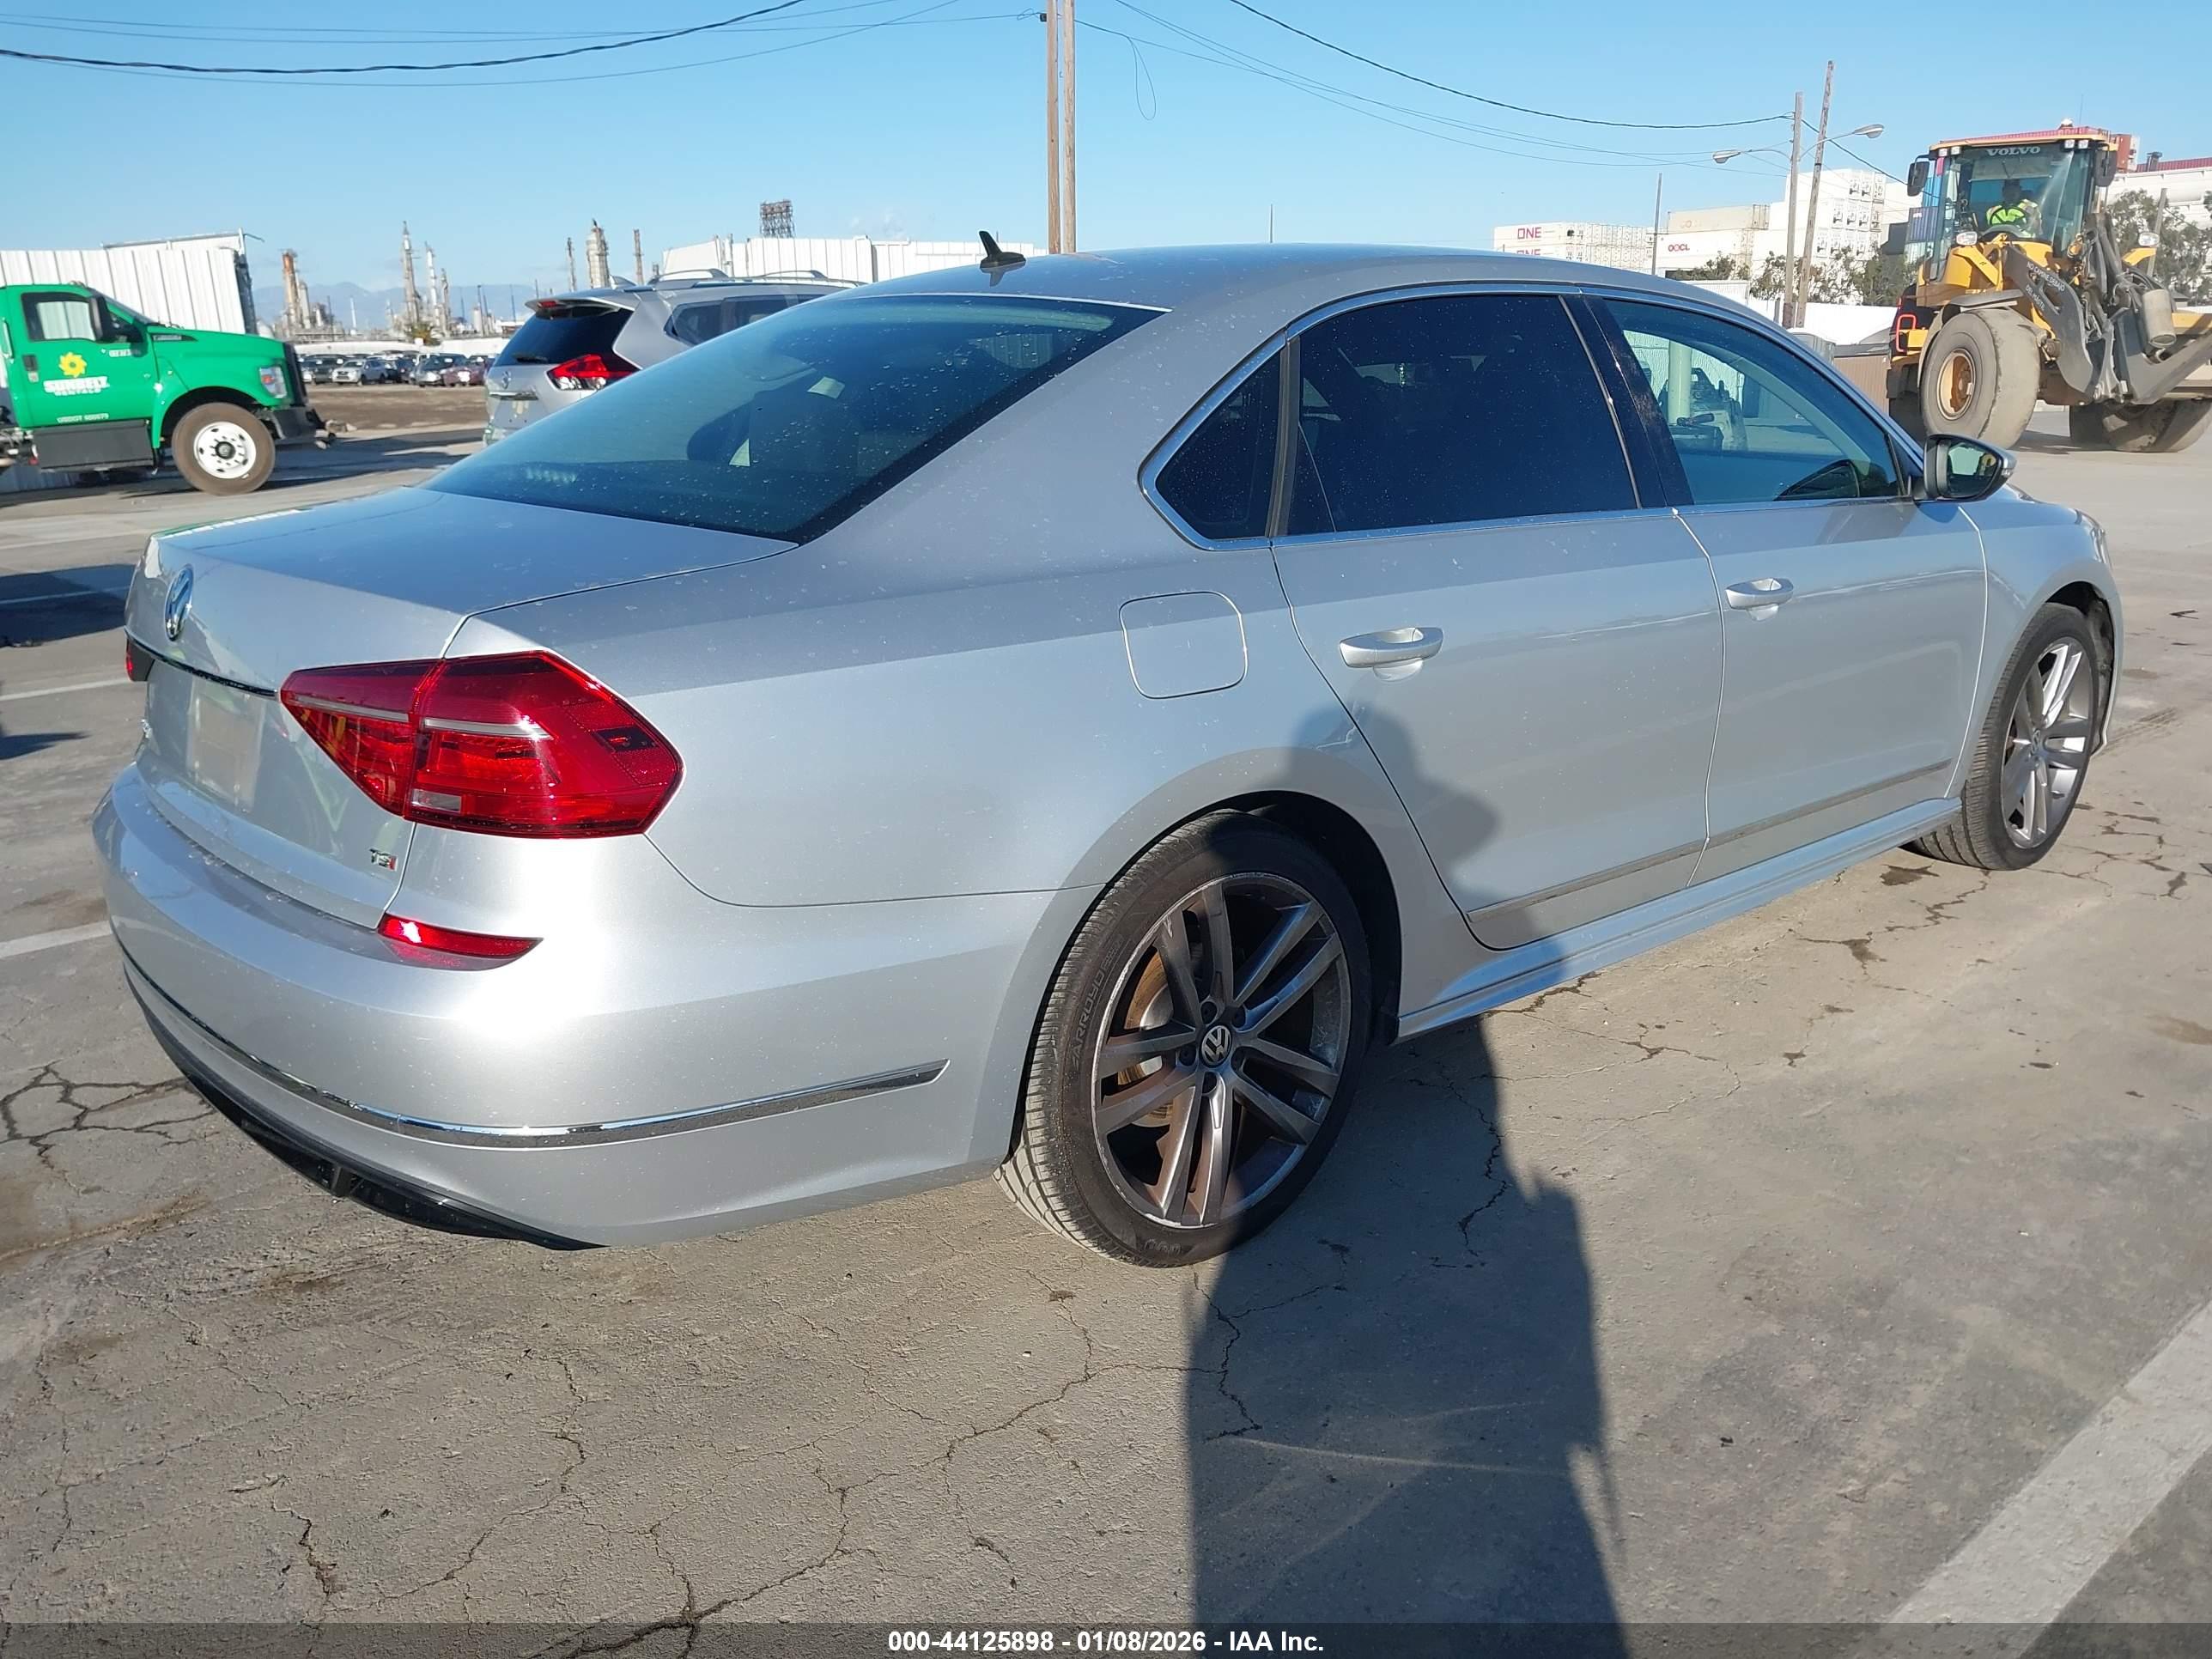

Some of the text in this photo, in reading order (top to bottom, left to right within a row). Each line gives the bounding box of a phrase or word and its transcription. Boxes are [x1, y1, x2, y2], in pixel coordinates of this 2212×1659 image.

[1986, 146, 2041, 156] VOLVO
[1517, 227, 1542, 240] ONE
[1668, 244, 1691, 252] OOCL
[369, 848, 398, 871] TSI
